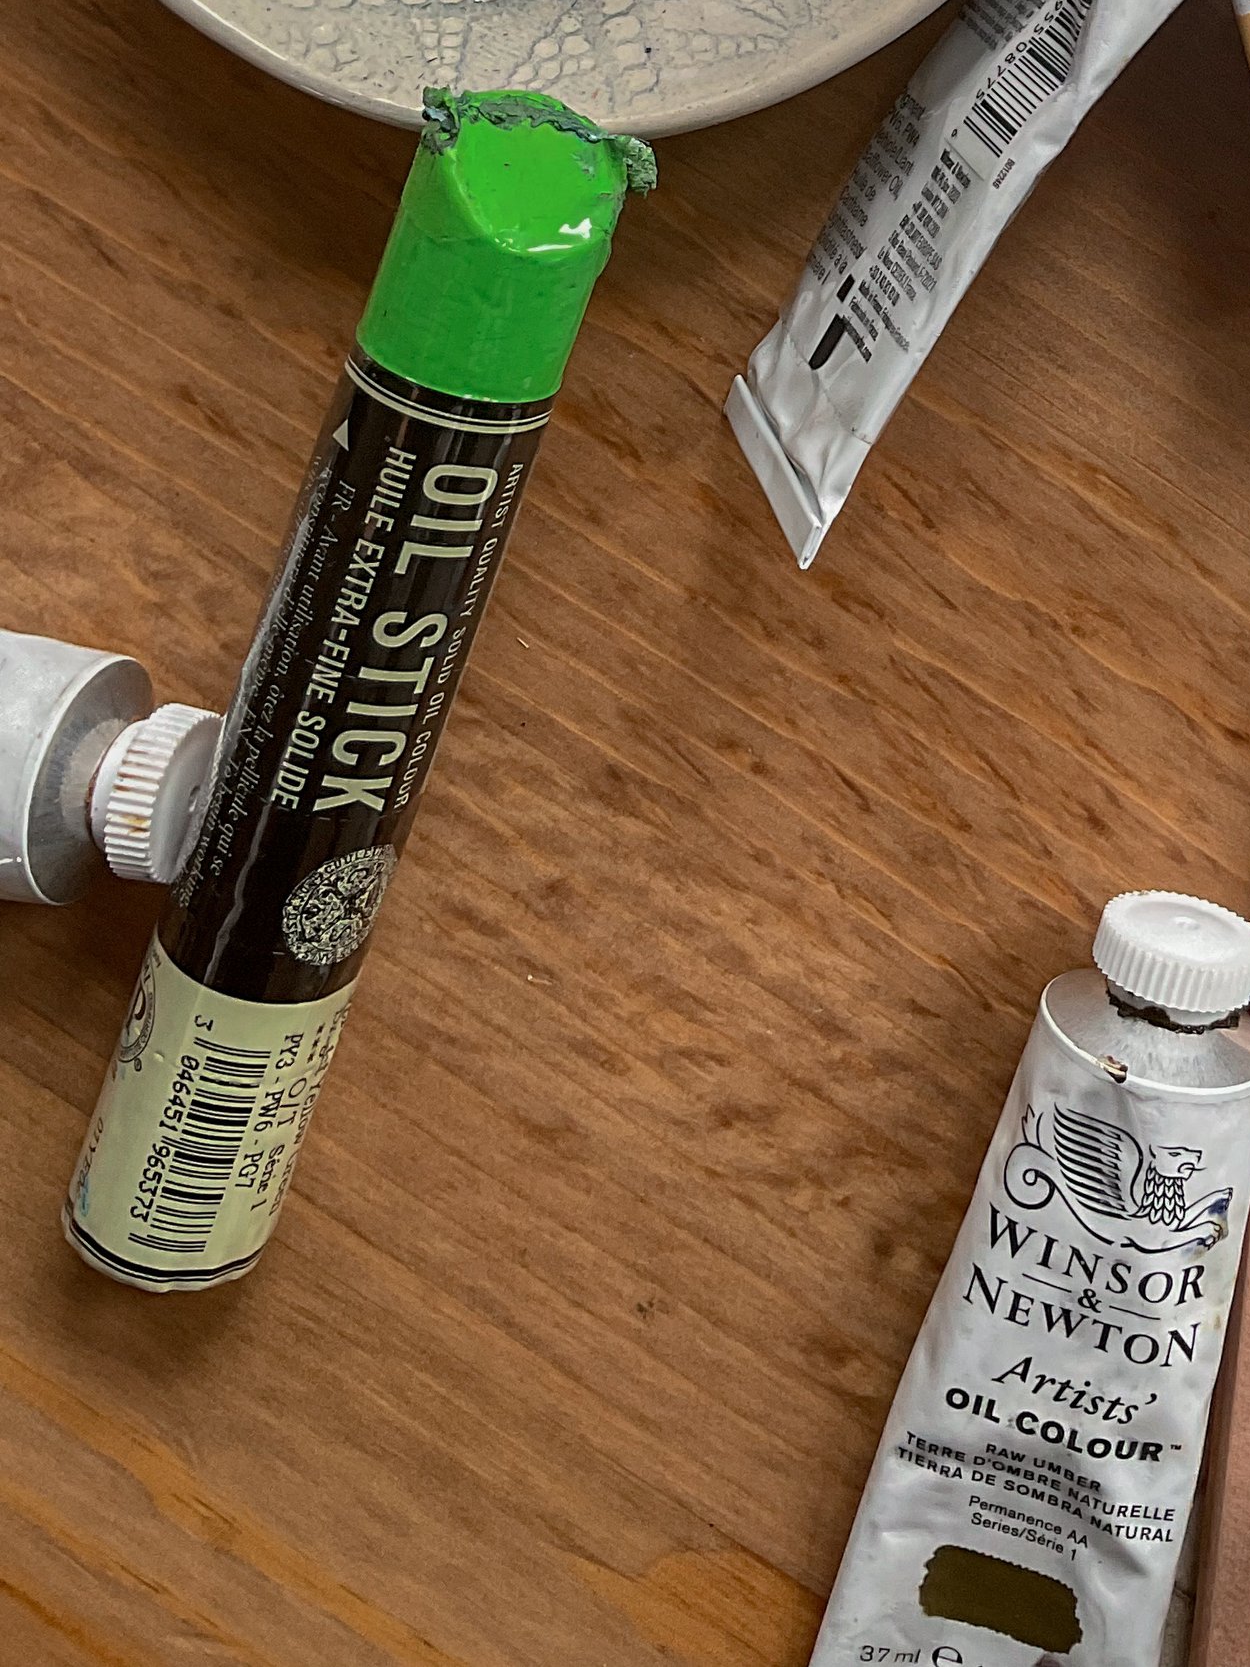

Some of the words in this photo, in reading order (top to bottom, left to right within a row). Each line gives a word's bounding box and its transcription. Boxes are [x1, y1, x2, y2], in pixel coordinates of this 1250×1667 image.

[361, 446, 418, 531] HUILE
[394, 463, 500, 575] OIL
[494, 463, 525, 529] ARTIST
[460, 537, 499, 618] QUALITY
[305, 540, 386, 704] EXTRA-FINE
[436, 626, 467, 689] SOLID
[314, 610, 449, 812] STICK
[426, 691, 446, 724] OIL
[269, 710, 326, 809] SOLIDE
[394, 730, 433, 809] COLOUR
[275, 1033, 304, 1069] PY3
[160, 1054, 200, 1133] 046451
[253, 1089, 284, 1132] PW6
[130, 1144, 172, 1224] 965373
[235, 1149, 265, 1188] PG7
[987, 1202, 1204, 1306] WINSOR
[963, 1264, 1201, 1368] NEWTON
[1078, 1289, 1102, 1314] &
[945, 1388, 1000, 1423] OIL
[992, 1355, 1157, 1425] Artists'
[898, 1447, 962, 1481] TIERRA
[971, 1467, 995, 1487] DE
[1003, 1478, 1084, 1522] SOMBRA
[1090, 1514, 1174, 1543] NATURAL
[906, 1431, 966, 1463] TERRE
[972, 1449, 1062, 1492] D'OMBRE
[1067, 1484, 1175, 1522] NATURELLE
[985, 1442, 1023, 1464] RAW
[1032, 1456, 1101, 1493] UMBER
